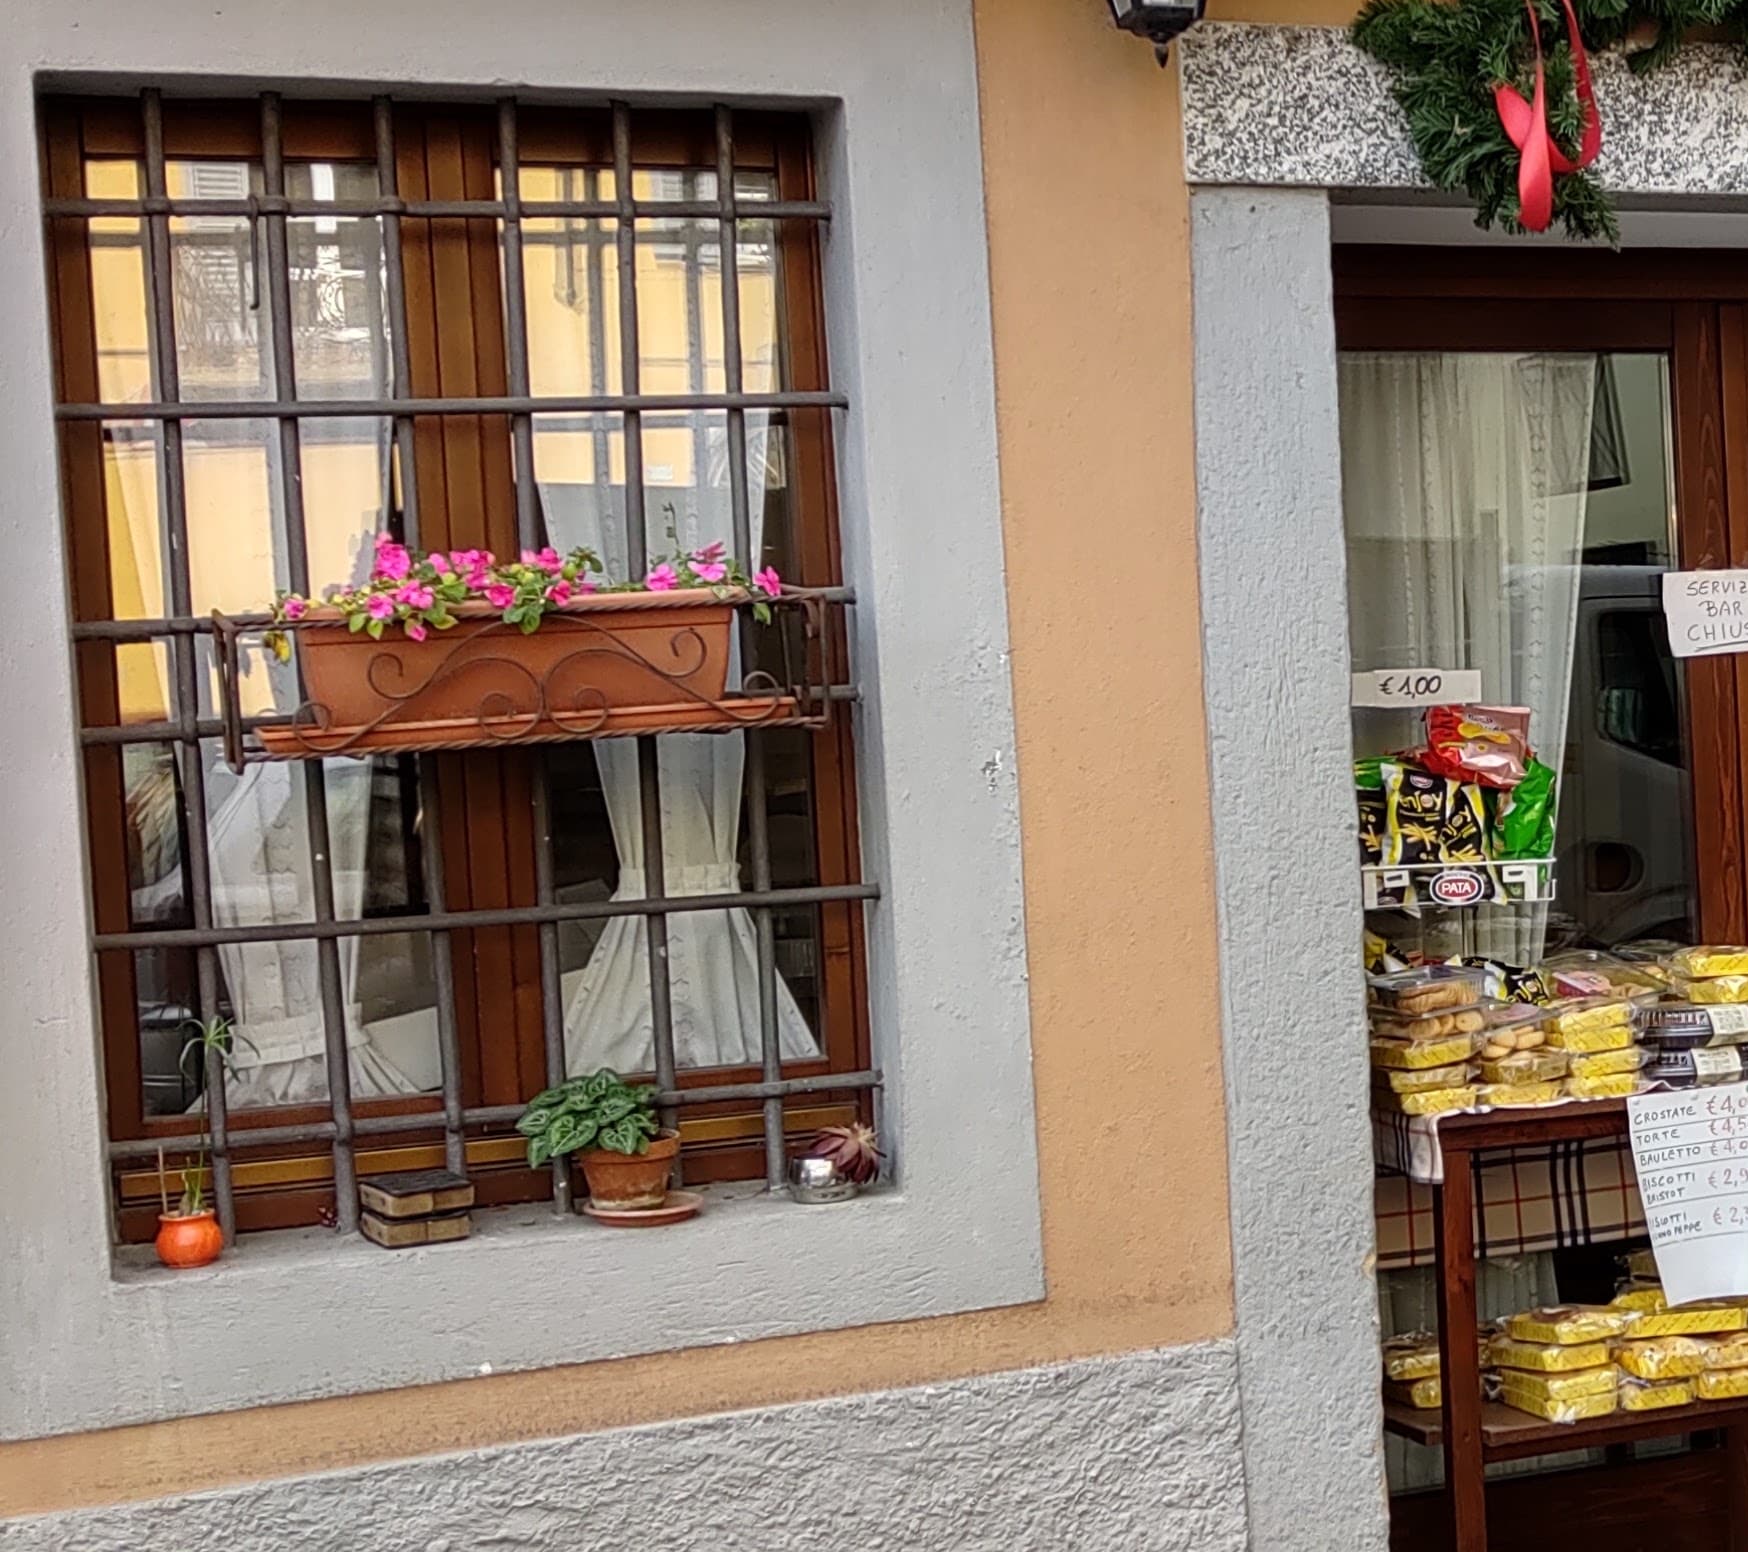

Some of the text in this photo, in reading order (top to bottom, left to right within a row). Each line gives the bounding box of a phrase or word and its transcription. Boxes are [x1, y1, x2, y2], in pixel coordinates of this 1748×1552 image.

[1698, 600, 1743, 617] BAR
[1441, 882, 1472, 894] PATA
[1634, 1105, 1697, 1126] CROSTATE
[1636, 1129, 1680, 1146] TORTE
[1639, 1146, 1701, 1166] BAULETTO
